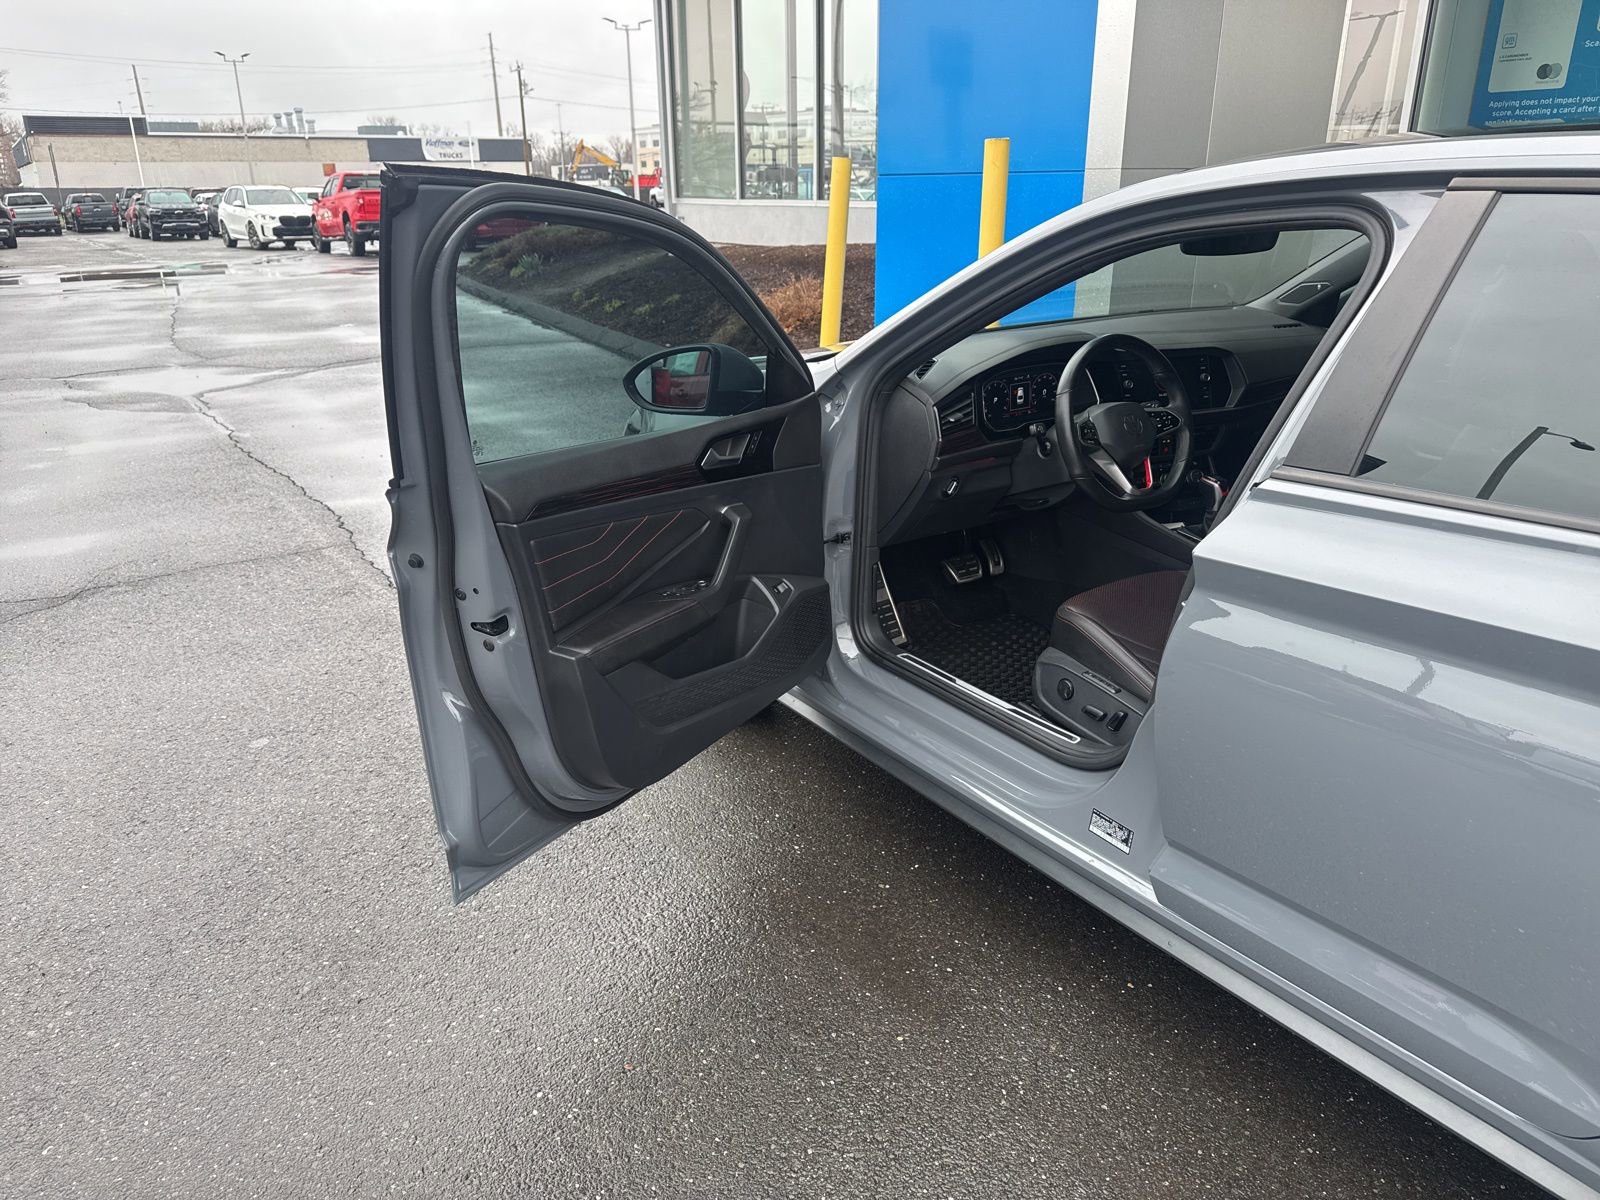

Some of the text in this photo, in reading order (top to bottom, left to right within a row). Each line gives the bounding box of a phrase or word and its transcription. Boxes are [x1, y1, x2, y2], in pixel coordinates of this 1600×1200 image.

[1585, 40, 1600, 48] Sca
[1489, 96, 1600, 108] Applying does not impact your
[1514, 107, 1551, 116] Accepting
[1559, 105, 1576, 114] card
[1577, 104, 1597, 113] after
